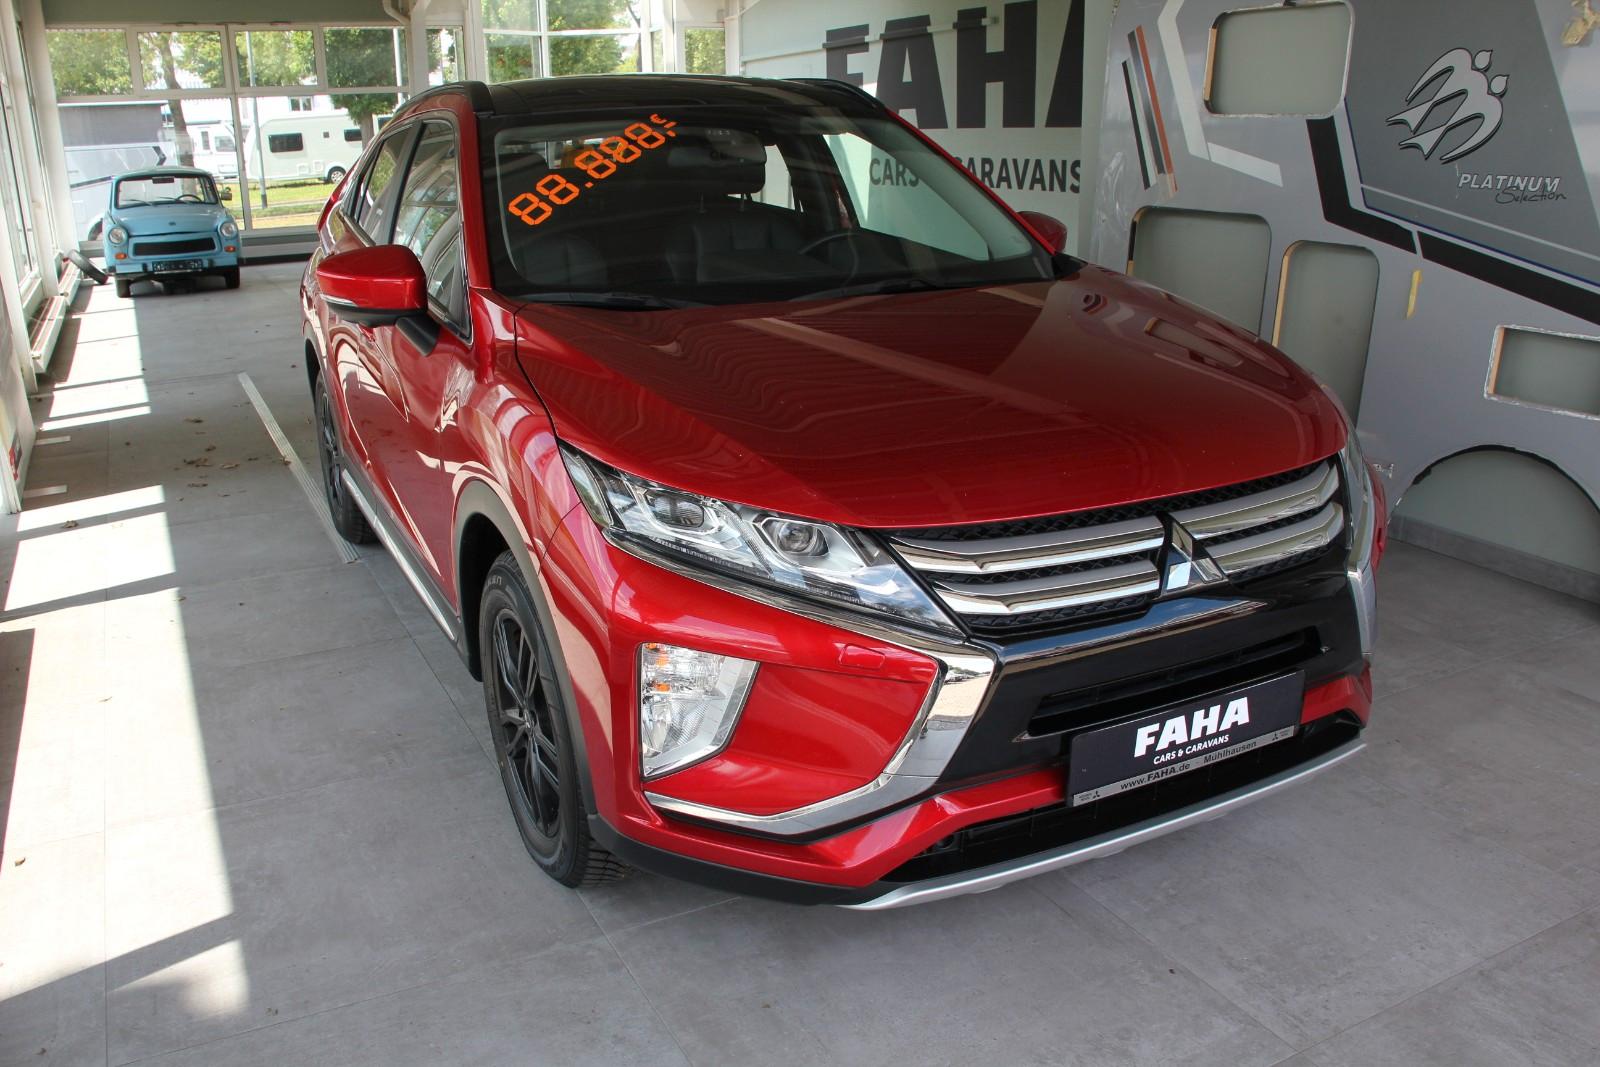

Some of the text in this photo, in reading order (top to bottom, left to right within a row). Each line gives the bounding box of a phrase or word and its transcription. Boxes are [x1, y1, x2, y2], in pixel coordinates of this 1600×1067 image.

[954, 156, 1081, 194] ARAVANS
[1458, 173, 1561, 193] PLATINUM
[1495, 186, 1567, 204] Selection
[1133, 696, 1250, 758] FAHA
[1120, 741, 1257, 790] www.FAHA.de Mühlhausen
[1153, 734, 1230, 765] CARS & CARAVANS
